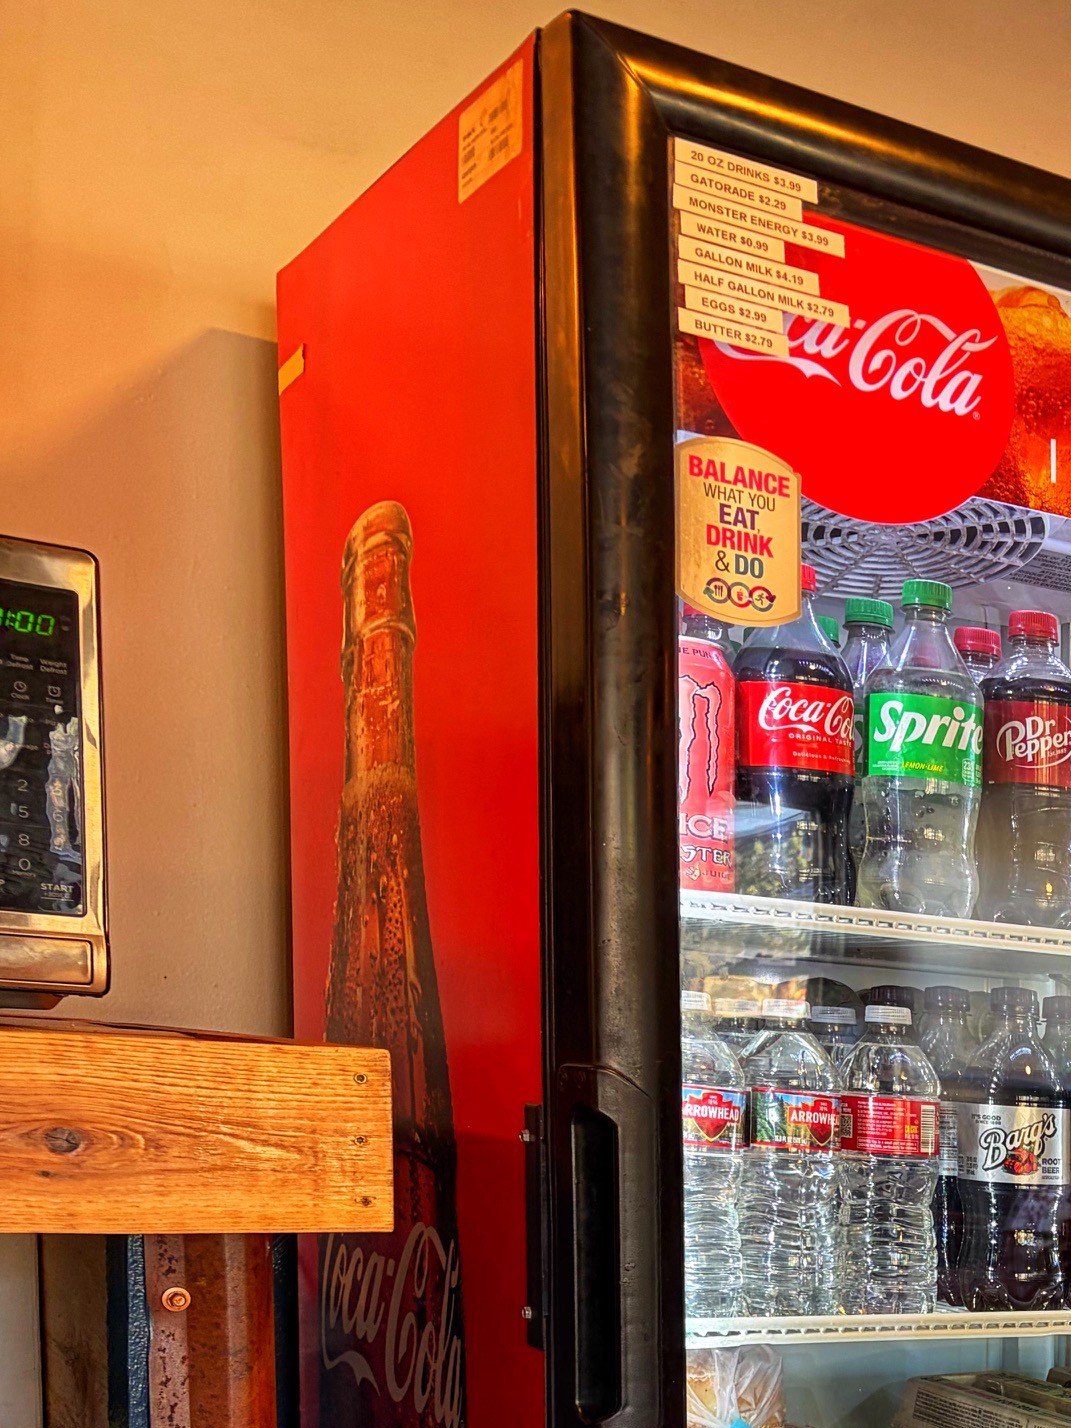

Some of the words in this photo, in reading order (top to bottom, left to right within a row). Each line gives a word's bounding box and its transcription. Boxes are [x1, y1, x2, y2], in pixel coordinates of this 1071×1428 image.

[691, 151, 703, 162] 20
[707, 156, 724, 169] OZ
[728, 161, 770, 183] DRINKS
[773, 176, 801, 192] $3.99
[690, 173, 755, 201] GATORADE
[758, 194, 786, 210] $2.29
[689, 197, 747, 223] MONSTER
[750, 216, 798, 237] ENERGY
[801, 230, 829, 246] $3.99
[696, 223, 737, 243] WATER
[740, 236, 769, 252] $0.99
[694, 247, 742, 269] GALLON
[746, 261, 773, 278] MILK
[775, 270, 804, 286] $4.19
[694, 271, 724, 287] HALF
[728, 281, 775, 302] GALLON
[778, 294, 804, 309] MILK
[807, 302, 834, 318] $2.79
[701, 297, 735, 314] EGGS
[739, 307, 767, 323] $2.99
[694, 319, 742, 341] BUTTER
[745, 333, 773, 349] $2.79
[783, 308, 998, 416] ca-Cola
[688, 454, 791, 498] BALANCE
[703, 482, 744, 504] WHAT
[748, 492, 776, 512] YOU
[719, 503, 761, 533] EAT,
[706, 524, 774, 558] DRINK
[715, 551, 730, 573] &
[734, 554, 764, 579] DO
[758, 686, 854, 740] Coca-Col
[873, 700, 983, 755] Sprite
[1025, 715, 1056, 741] Dr
[788, 733, 833, 743] ORIGINAL
[17, 779, 28, 792] 2
[18, 805, 30, 819] 5
[18, 833, 30, 847] 8
[680, 812, 728, 843] ICE
[18, 858, 31, 871] 0
[680, 845, 733, 869] STER
[40, 882, 74, 893] START
[682, 1103, 740, 1122] RROWHEAD
[979, 1113, 1057, 1171] Barq's
[1042, 1158, 1061, 1166] ROOT
[1042, 1166, 1060, 1174] BEER
